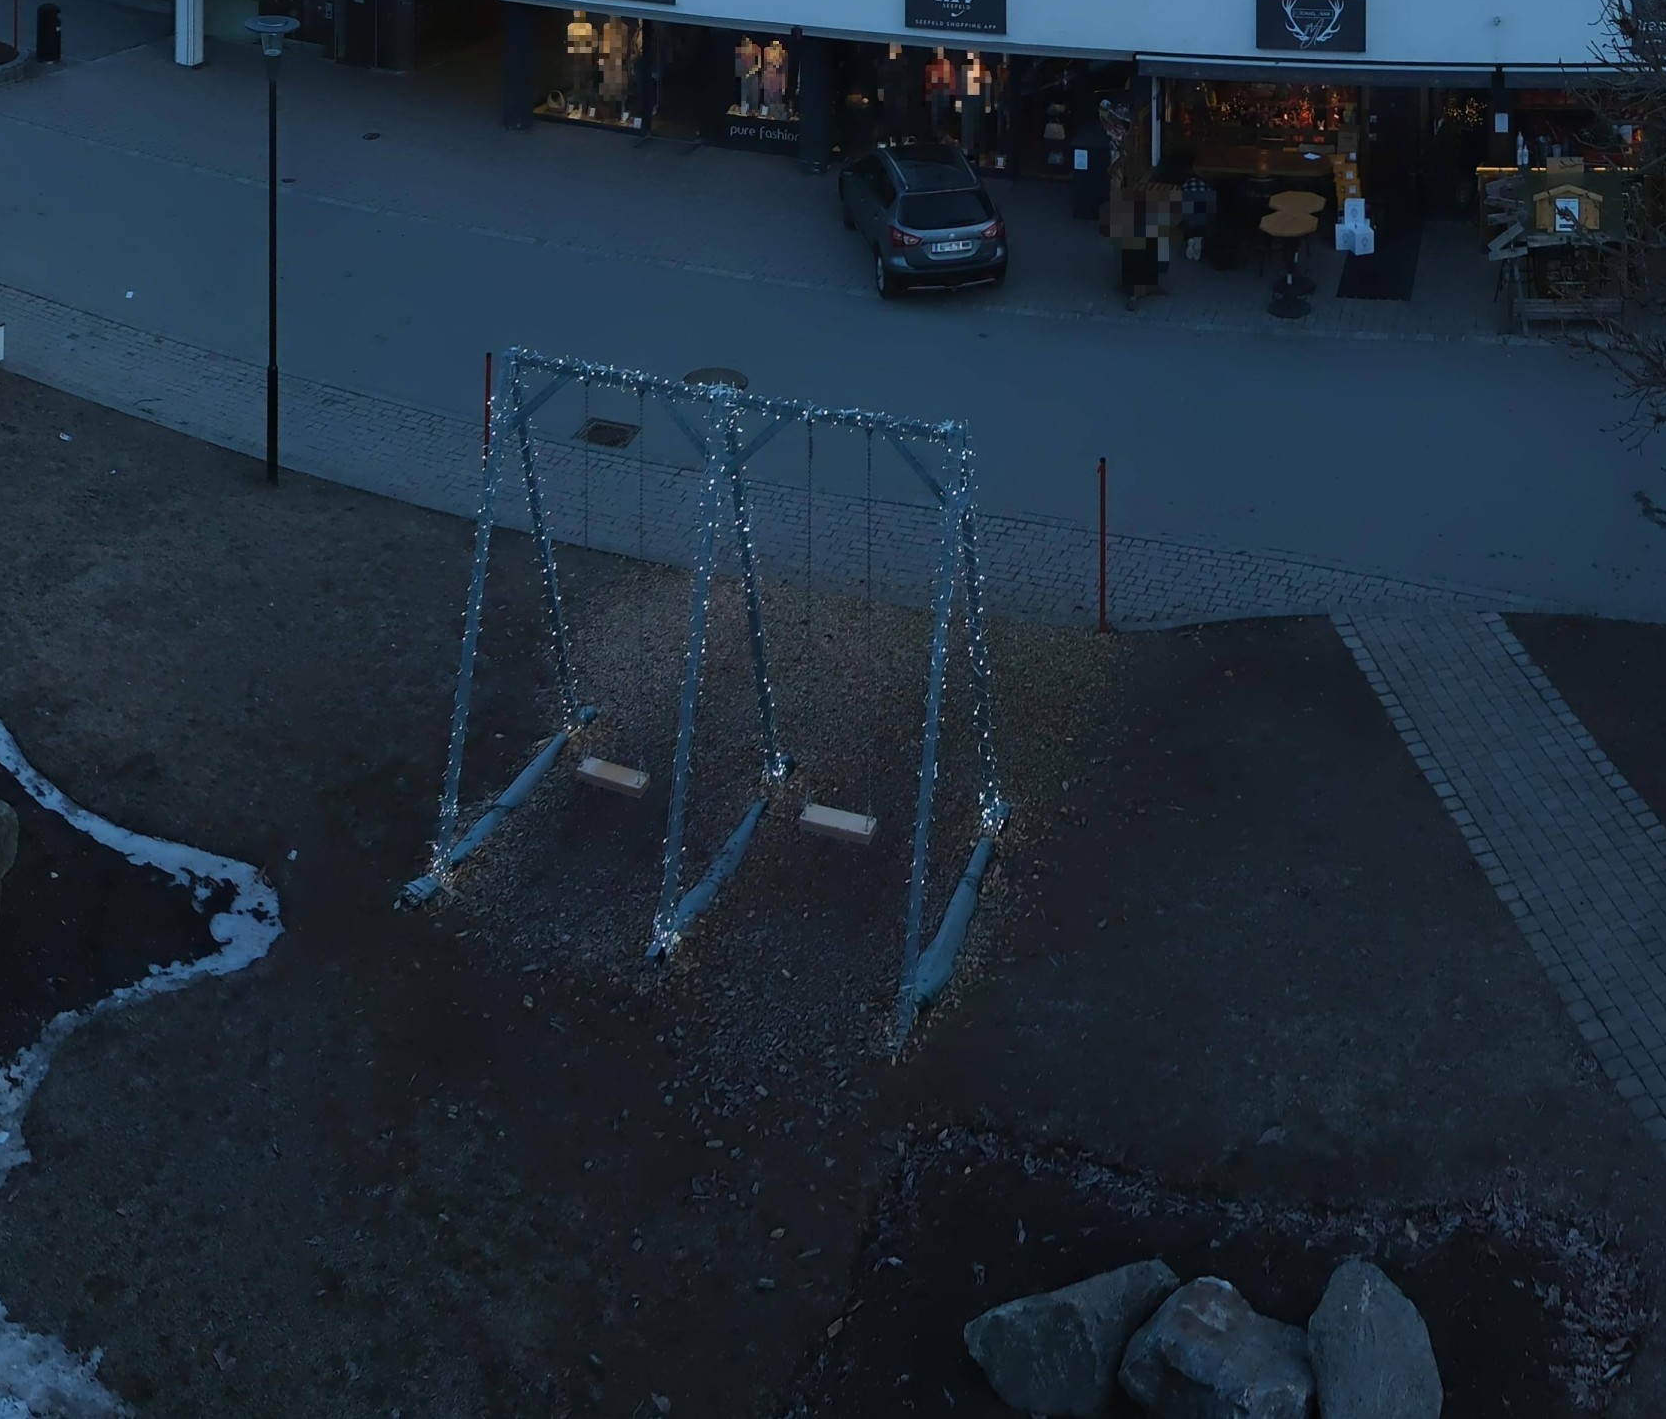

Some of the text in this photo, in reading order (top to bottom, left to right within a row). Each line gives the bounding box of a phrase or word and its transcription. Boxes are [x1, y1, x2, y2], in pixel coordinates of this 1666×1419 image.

[942, 3, 972, 11] SEEFELD
[914, 19, 944, 27] SEEFELD
[946, 21, 982, 30] SHOPPING
[729, 125, 756, 137] pure
